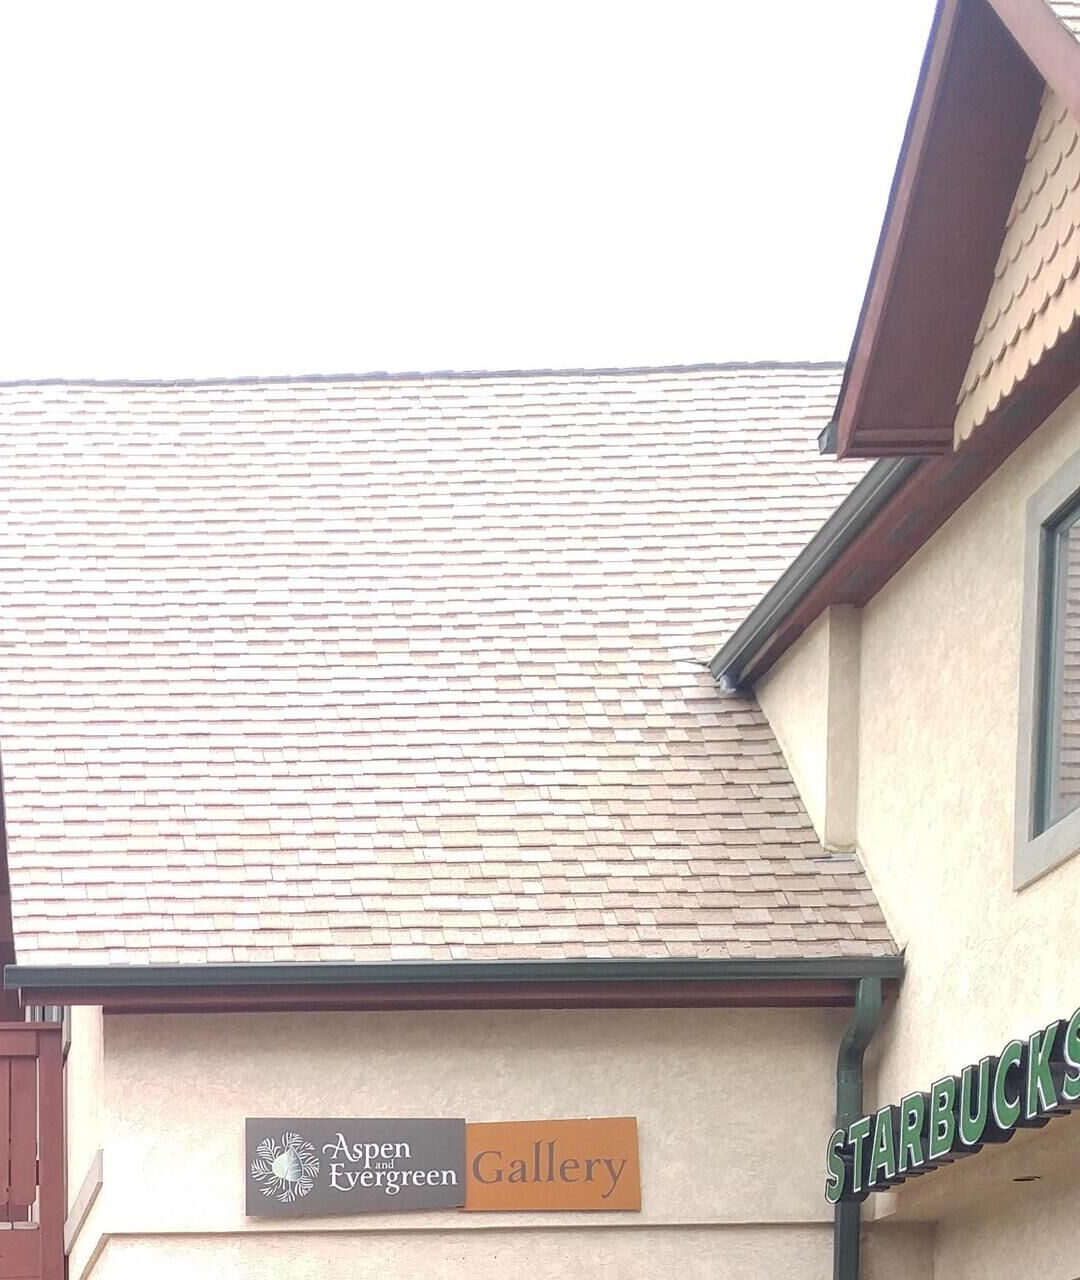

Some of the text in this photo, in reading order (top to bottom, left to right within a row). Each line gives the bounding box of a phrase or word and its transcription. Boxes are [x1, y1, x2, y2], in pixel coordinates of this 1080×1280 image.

[824, 1006, 1080, 1204] STARBUCKS
[322, 1132, 411, 1169] Aspen
[375, 1159, 394, 1169] and
[472, 1139, 627, 1199] Gallery
[328, 1162, 458, 1195] Evergreen
